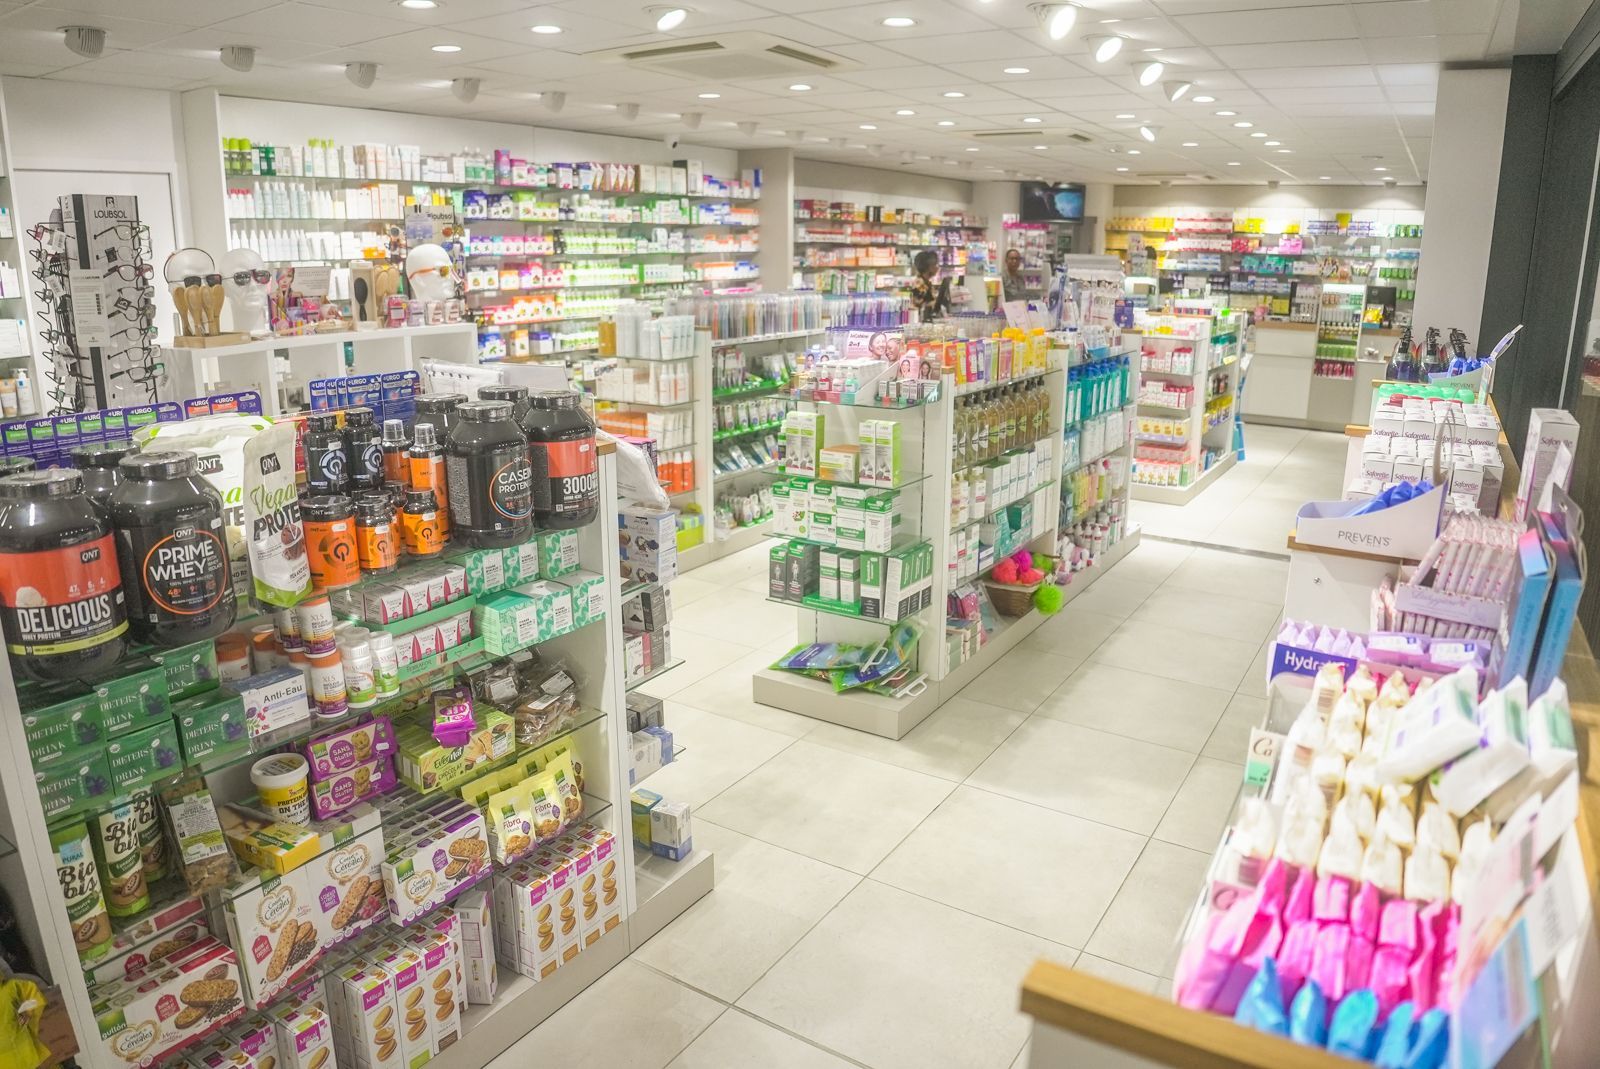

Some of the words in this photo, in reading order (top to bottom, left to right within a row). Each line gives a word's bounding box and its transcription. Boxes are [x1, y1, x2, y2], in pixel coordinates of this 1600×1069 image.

[94, 210, 128, 219] LOUBSOL
[219, 396, 234, 404] URGO
[88, 413, 101, 421] URG
[134, 407, 153, 415] URGO
[39, 420, 52, 428] URG
[63, 416, 77, 424] URG
[263, 456, 278, 469] QNT
[563, 474, 592, 495] 3000
[1454, 480, 1479, 489] Saforelle
[253, 502, 302, 541] PROTE
[176, 528, 193, 538] QNT
[1337, 529, 1392, 548] PREVEN'S
[82, 549, 99, 561] QNT
[158, 539, 214, 565] PRIME
[150, 557, 207, 581] WHEY
[17, 594, 111, 633] DELICIOUS
[263, 684, 303, 705] Anti-Eau
[103, 712, 135, 729] DRINK
[31, 741, 66, 759] DRINK
[188, 740, 217, 754] DRINK
[332, 746, 351, 756] SANS
[334, 752, 353, 761] GLUTEN
[115, 766, 146, 783] DRINK
[334, 782, 352, 793] SANS
[335, 788, 353, 798] GLUTEN
[279, 805, 291, 814] ON
[534, 801, 552, 814] Fibra
[104, 815, 137, 842] Bio
[503, 817, 522, 830] Fibra
[113, 833, 139, 855] bis
[57, 860, 96, 887] Bio
[63, 876, 98, 900] bis
[101, 1022, 127, 1040] gullón
